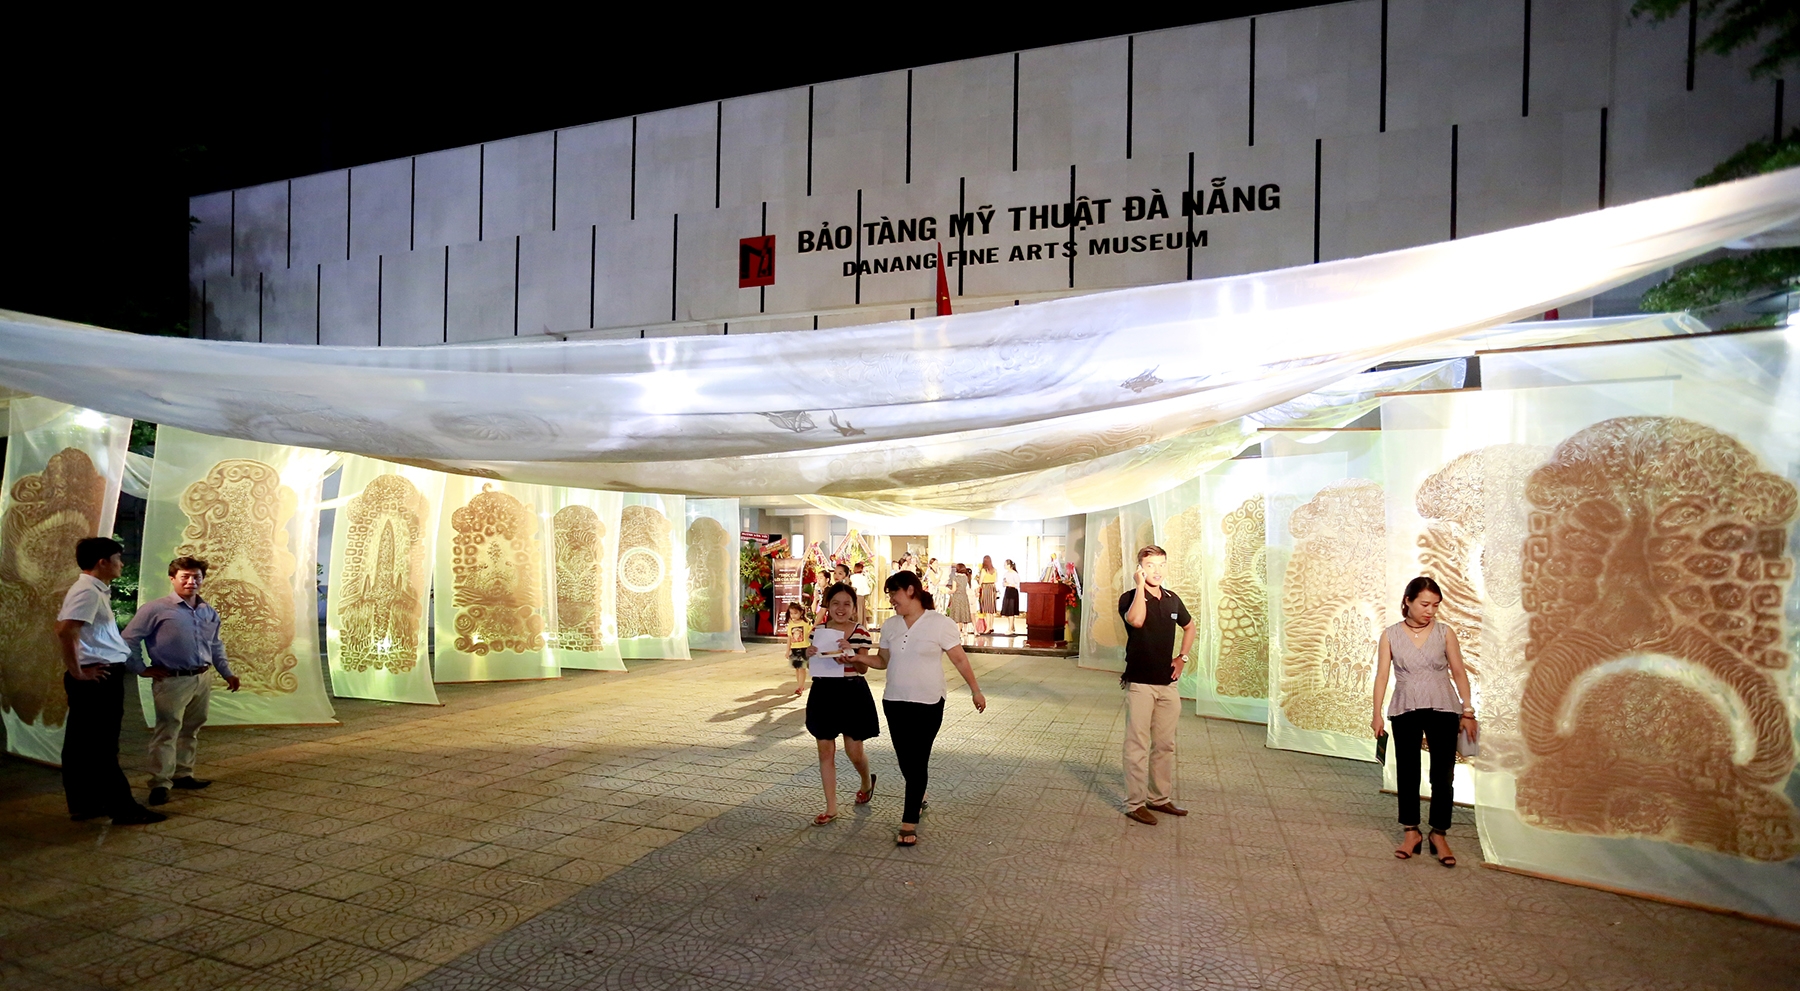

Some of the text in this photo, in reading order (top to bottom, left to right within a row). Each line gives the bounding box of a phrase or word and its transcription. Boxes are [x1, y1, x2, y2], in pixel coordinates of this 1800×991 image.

[798, 176, 1280, 253] BẢO TÀNG MỸ THUẬT ĐÀ NẴNG
[843, 230, 1208, 277] DANANG FINE ARTS MUSEUM
